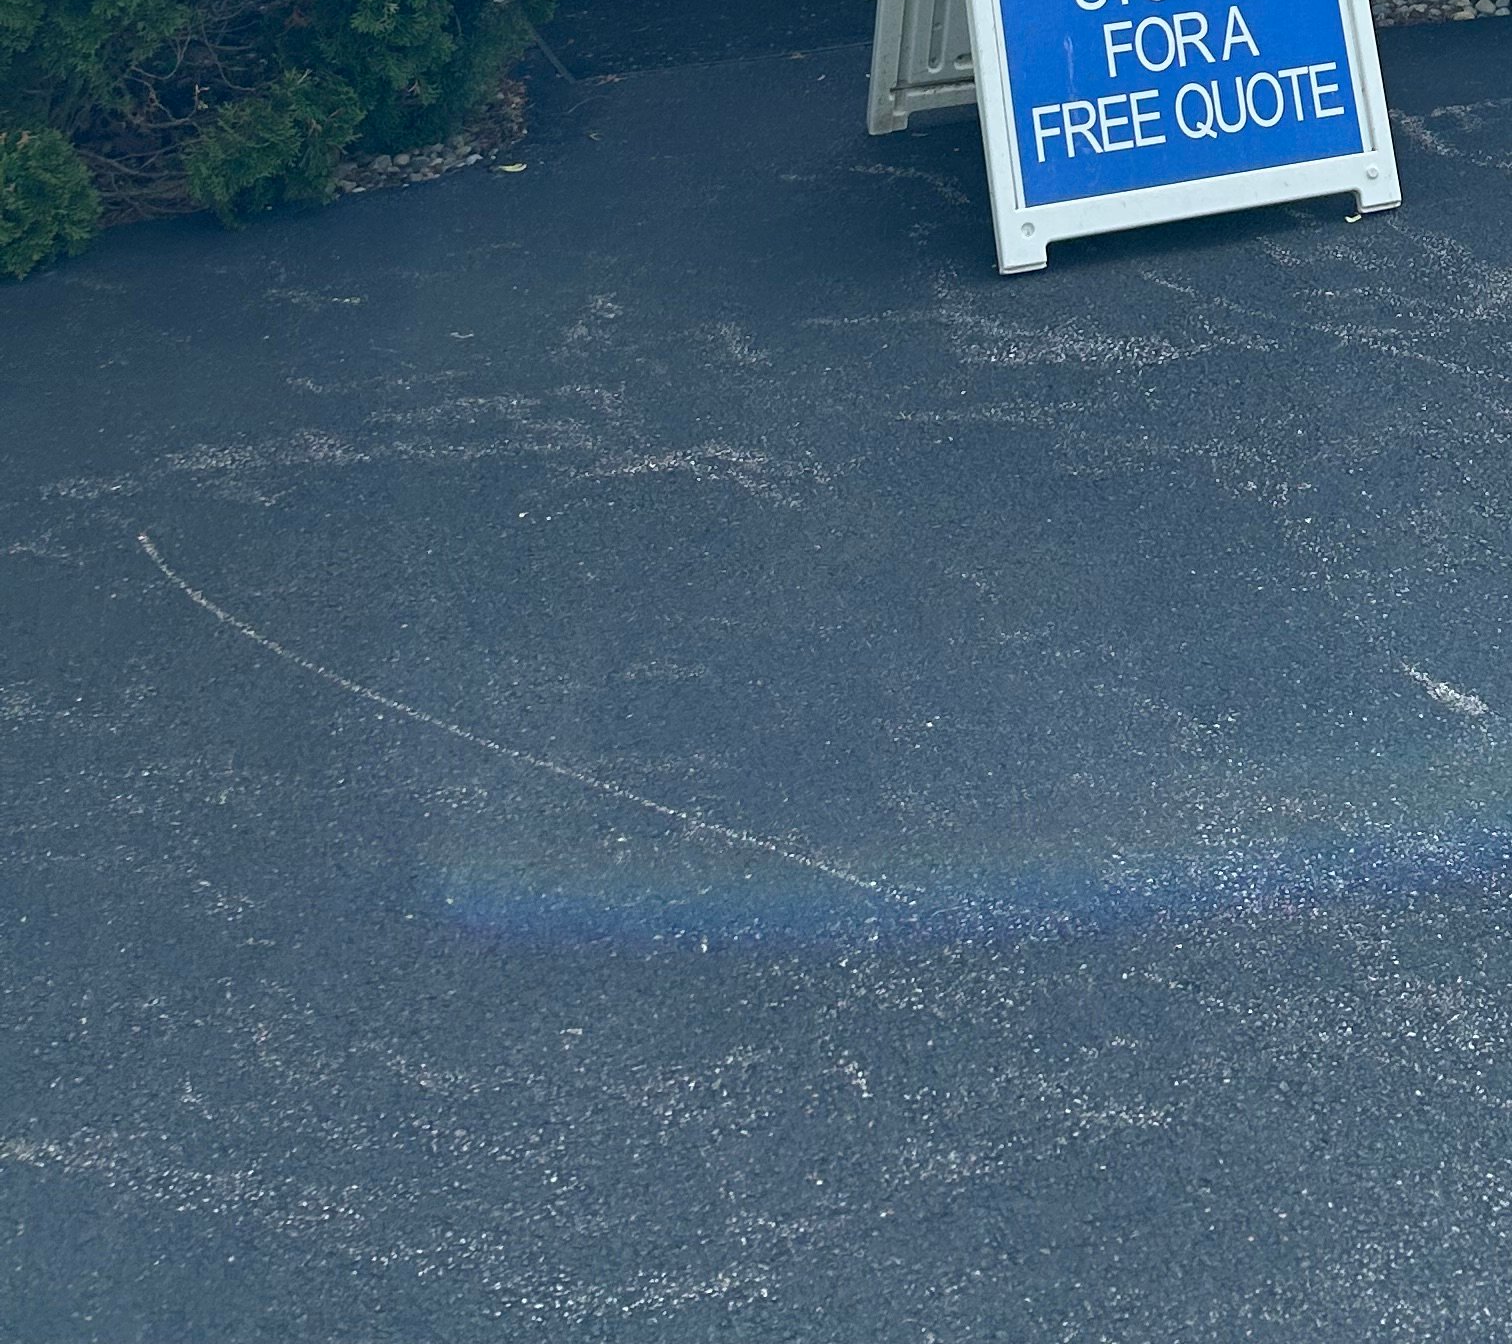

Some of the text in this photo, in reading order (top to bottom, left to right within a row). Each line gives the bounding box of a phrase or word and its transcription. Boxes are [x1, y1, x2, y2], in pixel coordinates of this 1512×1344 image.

[1103, 5, 1261, 78] FOR A
[1032, 62, 1345, 163] FREE QUOTE
